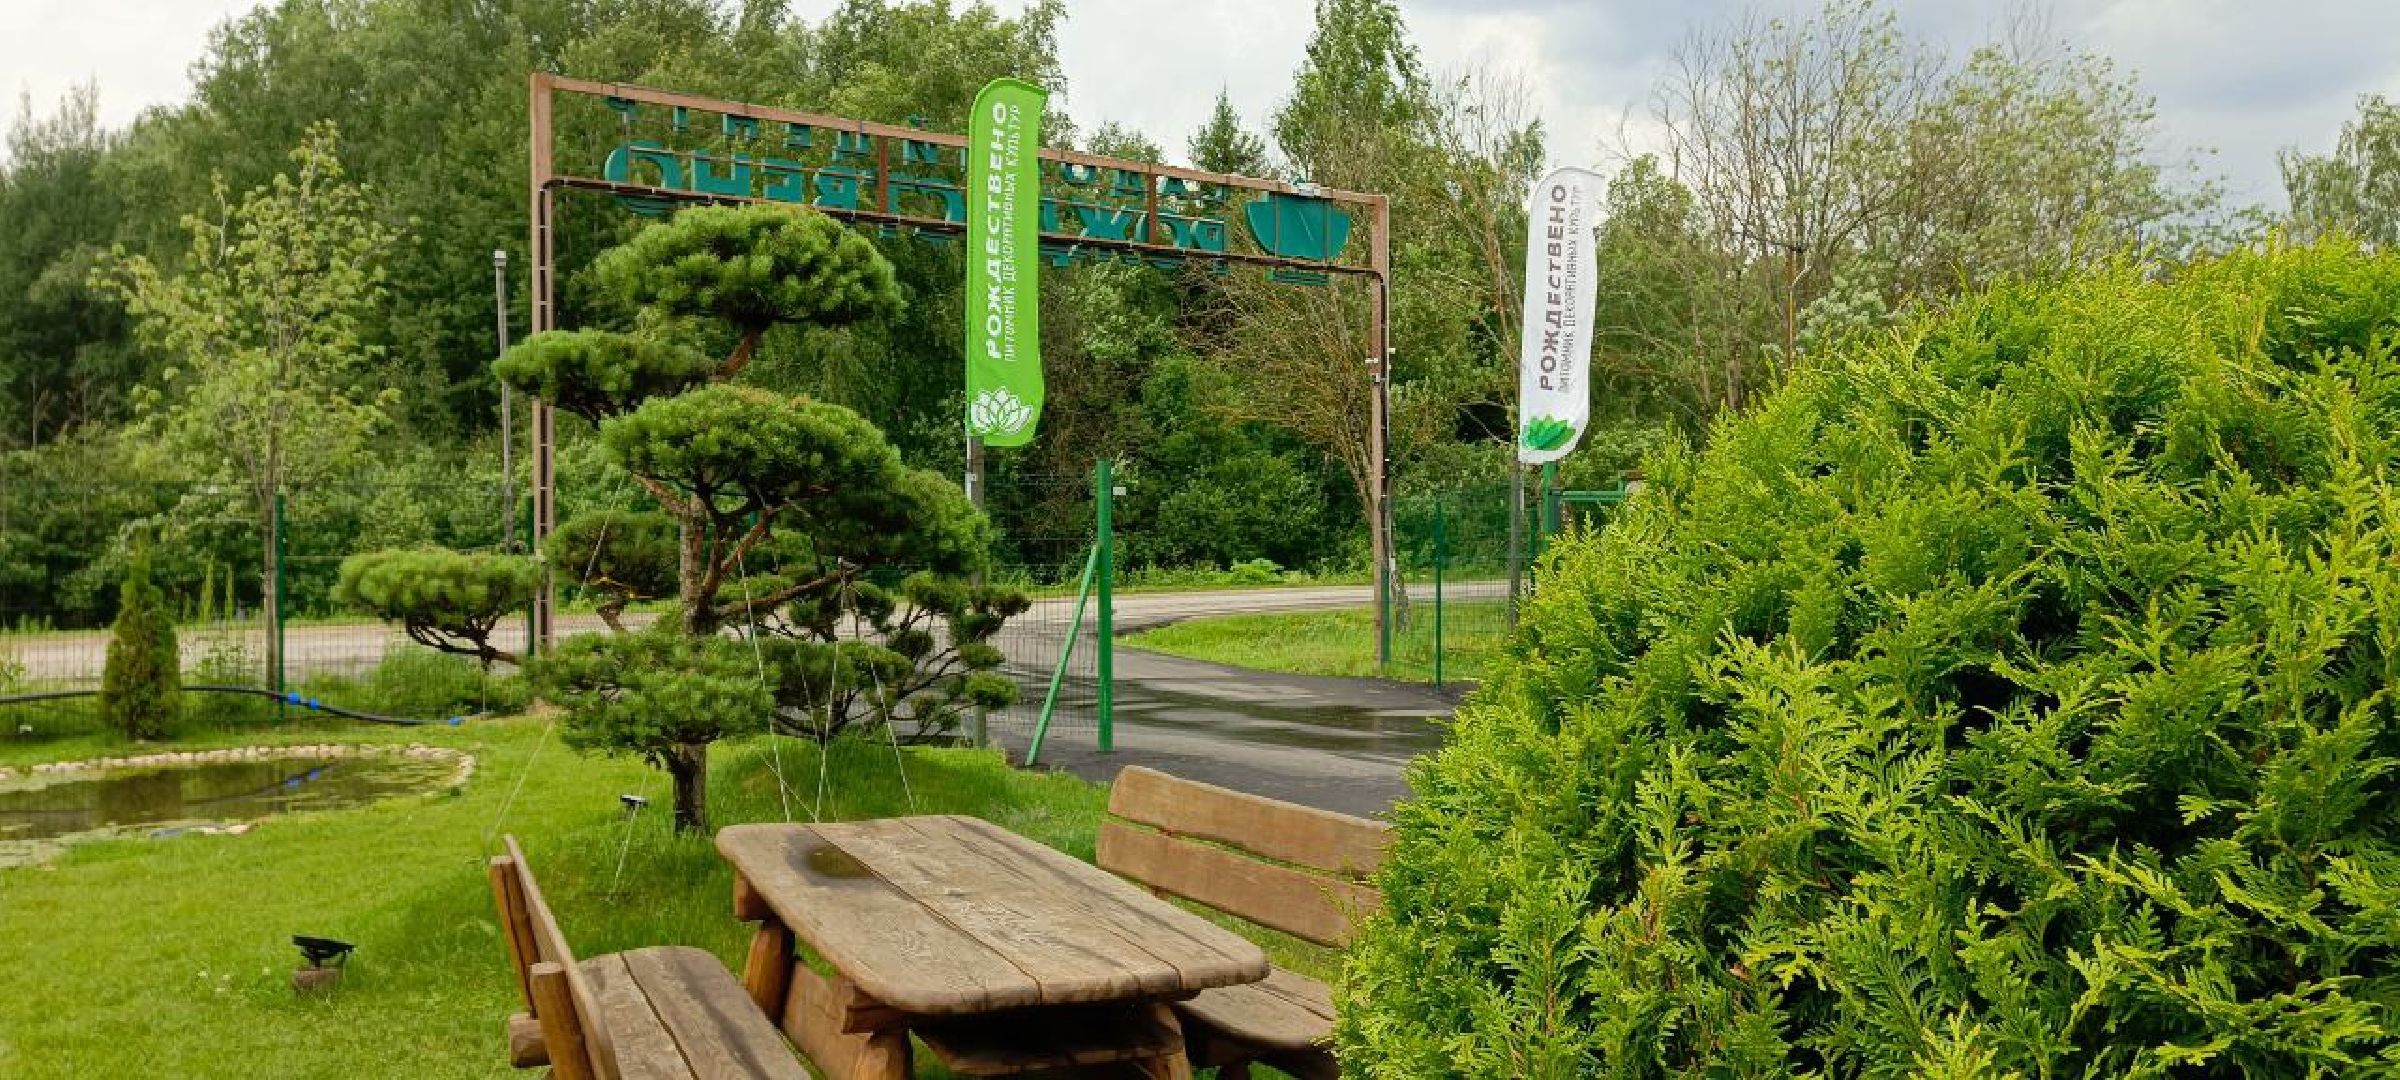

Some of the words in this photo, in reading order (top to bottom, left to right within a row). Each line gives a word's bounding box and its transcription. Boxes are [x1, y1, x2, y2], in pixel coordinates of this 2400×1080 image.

[1006, 104, 1021, 167] КУЛЬТУР
[985, 102, 1007, 360] РОЖДЕСТВЕНО
[1002, 173, 1017, 282] ДЕКОРАТИВНЫХ
[1003, 286, 1017, 362] ПИТОМНИК
[1540, 184, 1566, 391] РОЖДЕСТВЕНО
[1563, 239, 1579, 327] ДЕКОРАТИВНЫХ
[1557, 331, 1575, 393] ПИТОМНИК
